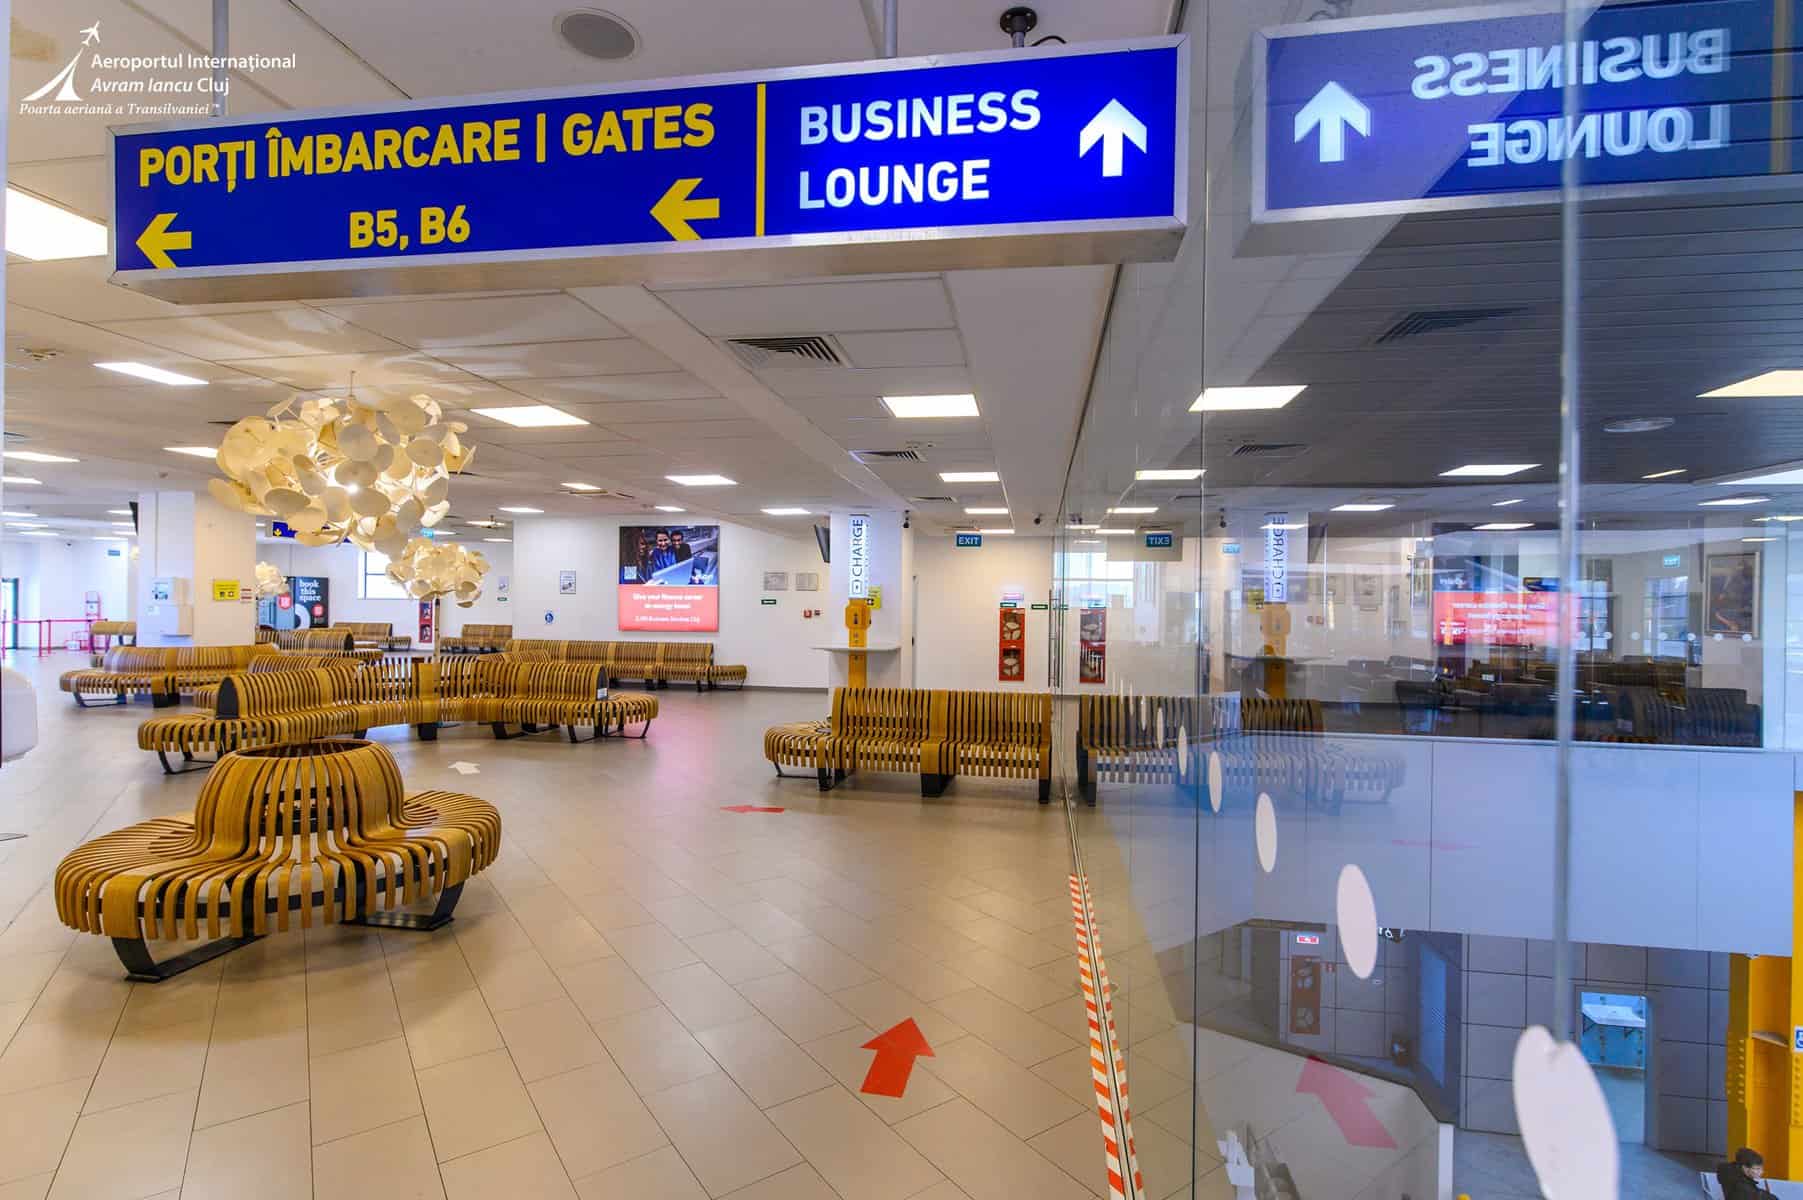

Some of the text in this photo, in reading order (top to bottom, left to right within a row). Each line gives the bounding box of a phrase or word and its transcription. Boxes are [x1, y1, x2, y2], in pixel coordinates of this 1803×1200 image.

[800, 89, 1041, 145] BUSINESS
[139, 140, 256, 193] PORȚI
[265, 119, 521, 178] ÎMBARCARE
[562, 103, 715, 157] GATES
[800, 159, 990, 209] LOUNGE
[350, 204, 471, 251] B5, B6
[852, 519, 863, 577] CHARGE
[958, 536, 979, 545] EXIT
[299, 579, 319, 588] book
[300, 587, 315, 595] this
